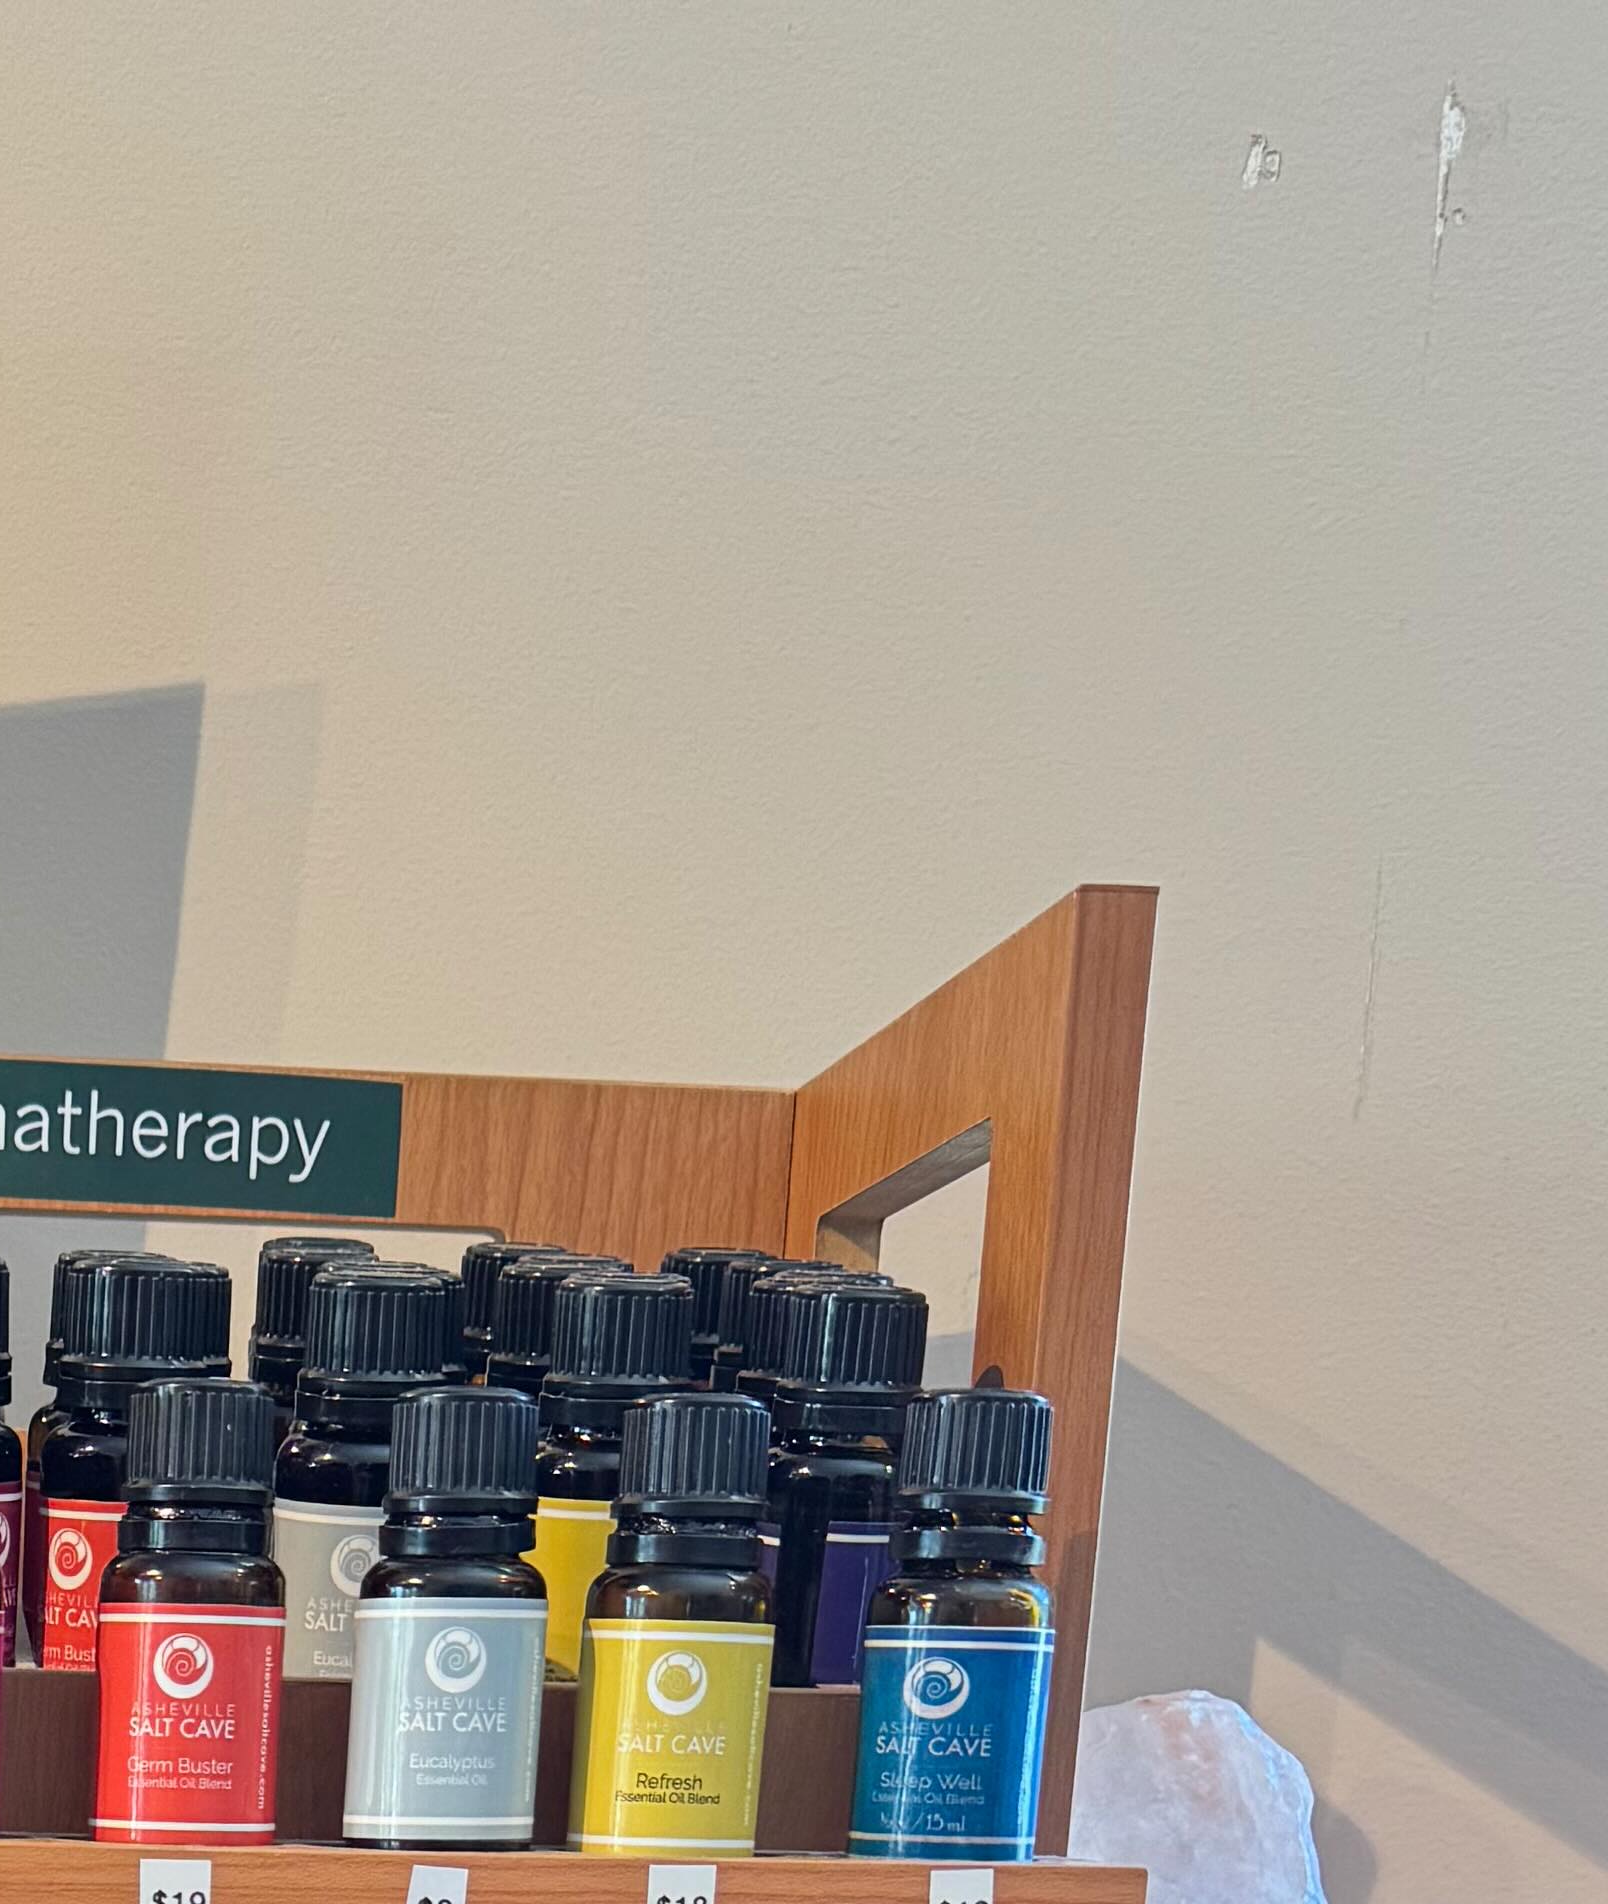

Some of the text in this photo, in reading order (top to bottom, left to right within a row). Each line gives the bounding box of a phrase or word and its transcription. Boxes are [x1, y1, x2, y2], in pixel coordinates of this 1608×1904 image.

[128, 1717, 235, 1739] SALT CAVE
[399, 1711, 507, 1733] SALT CAVE
[876, 1736, 991, 1757] SALT CAVE
[128, 1757, 233, 1775] Germ Buster
[410, 1753, 496, 1771] Eucalyptus
[637, 1773, 702, 1790] Refresh
